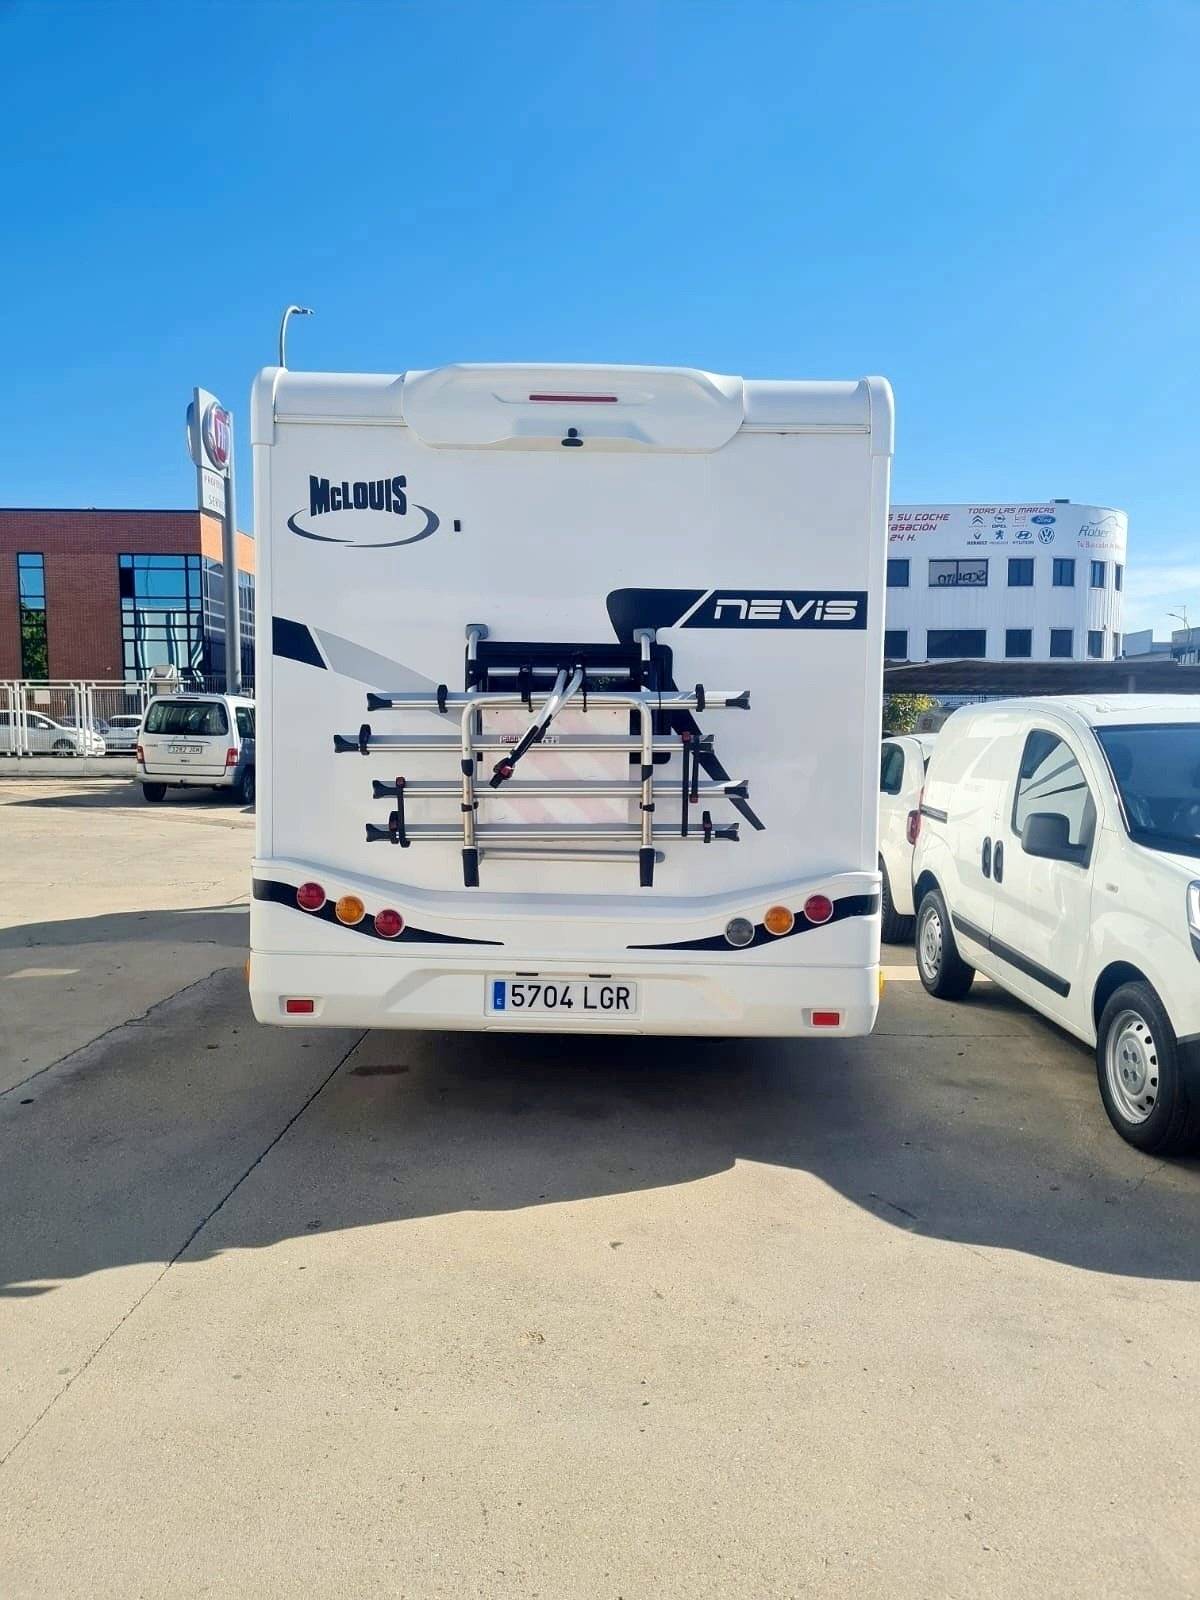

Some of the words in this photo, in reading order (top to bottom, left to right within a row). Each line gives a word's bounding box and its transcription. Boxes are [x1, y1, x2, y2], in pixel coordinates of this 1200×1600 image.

[309, 475, 407, 517] McLOUIS
[897, 513, 912, 521] SU
[914, 513, 951, 521] COCHE
[511, 984, 574, 1009] 5704
[583, 986, 630, 1010] LGR
